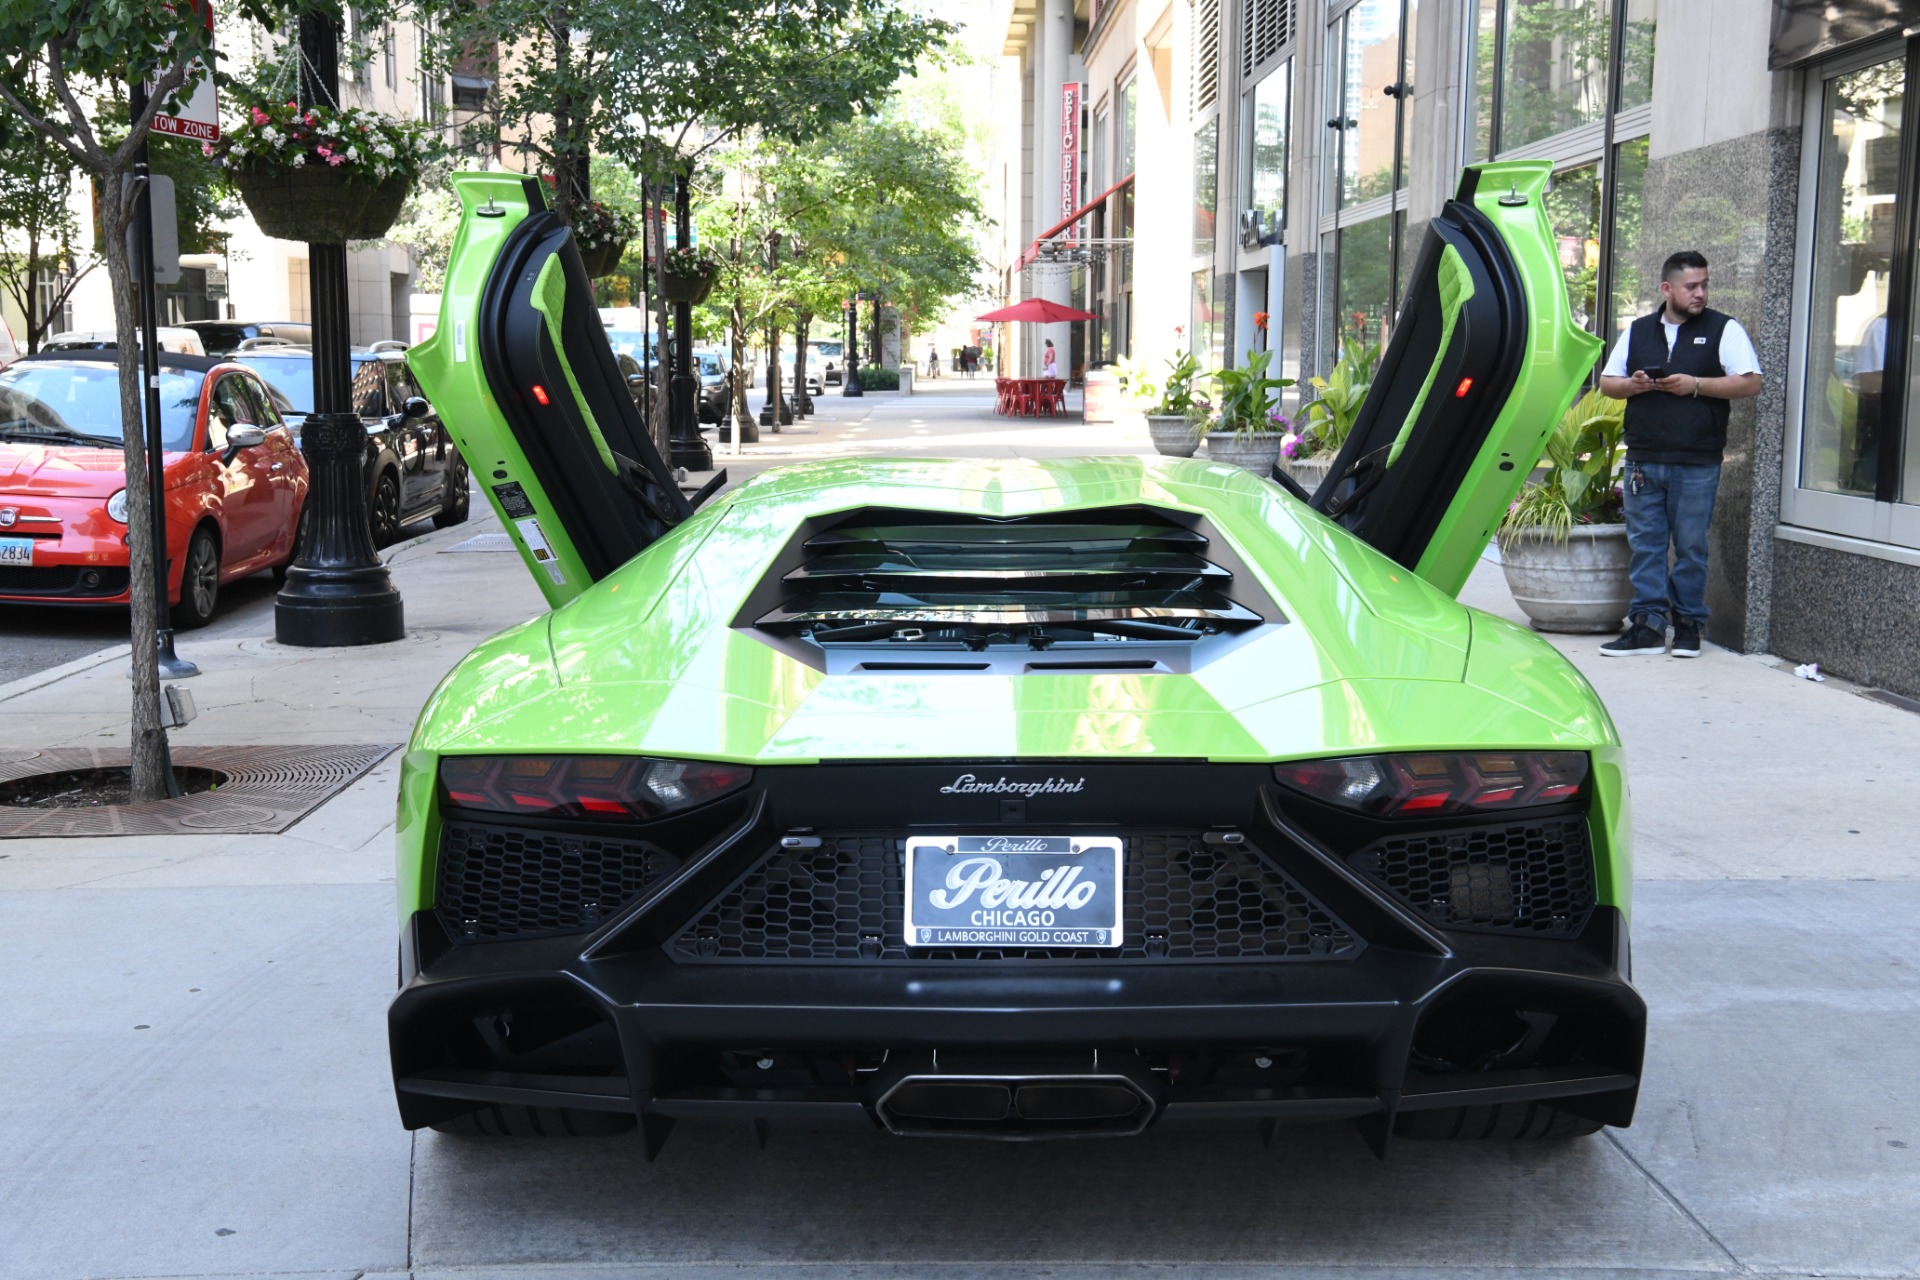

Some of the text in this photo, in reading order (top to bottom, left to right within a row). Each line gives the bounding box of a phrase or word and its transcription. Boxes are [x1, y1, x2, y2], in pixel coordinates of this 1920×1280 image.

[154, 115, 214, 139] TOW ZONE
[1063, 90, 1073, 149] EPIC
[0, 545, 30, 561] 2834
[939, 773, 1085, 798] Lamborghini
[980, 837, 1048, 852] Perillo
[929, 857, 1097, 910] Perillo
[970, 910, 1055, 927] CHICAGO
[938, 931, 1089, 943] LAMBORGHINI GOLD COAST
